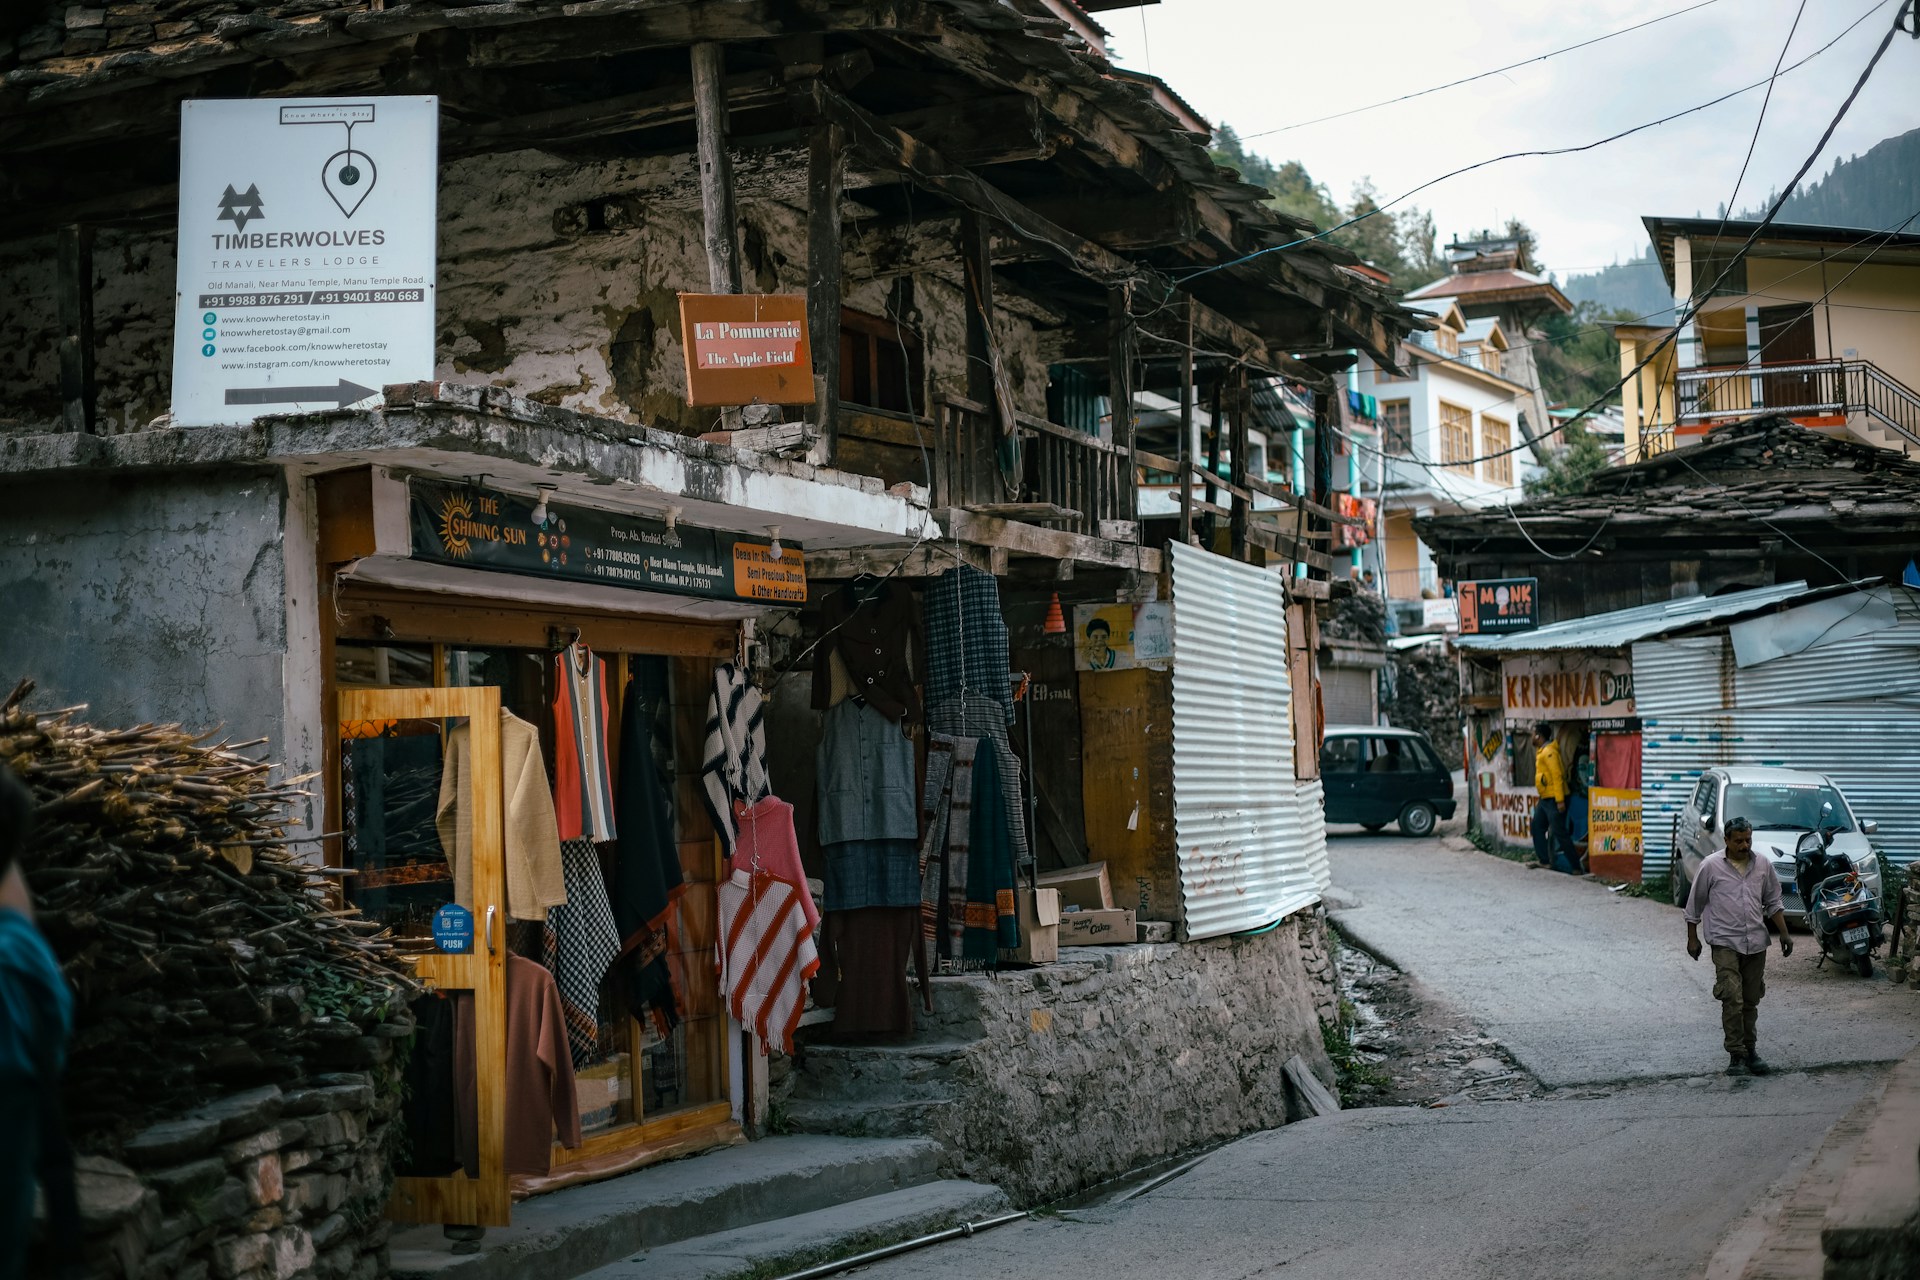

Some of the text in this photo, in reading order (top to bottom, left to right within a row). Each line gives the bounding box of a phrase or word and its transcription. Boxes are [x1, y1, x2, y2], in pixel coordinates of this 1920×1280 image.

[211, 229, 385, 250] TIMBERWOLVES
[211, 255, 379, 269] TRAVELERS LODGE
[208, 275, 426, 290] Old Manali, Near Manu Temple, Manu Temple Road.
[204, 296, 225, 306] +91
[228, 295, 257, 306] 9988
[259, 294, 281, 305] 876
[283, 293, 305, 304] 291
[319, 293, 340, 303] +91
[342, 292, 371, 302] 9401
[373, 291, 395, 302] 840
[397, 291, 419, 301] 668
[221, 313, 330, 324] www.knowwheretostay.in
[220, 326, 351, 337] knowwheretostay@gmail.com
[694, 321, 800, 340] La Pommeraie
[222, 341, 388, 354] www.facebook.com/knowwheretostay
[221, 357, 391, 370] www.instagram.com/knowwheretostay
[705, 350, 794, 367] The Apple Field
[479, 496, 499, 516] THE
[452, 518, 527, 545] SHINING SUN
[610, 526, 628, 542] Prop.
[629, 530, 641, 542] Ab.
[592, 547, 605, 560] +91
[735, 547, 752, 561] Deals
[593, 564, 606, 576] +91
[747, 566, 761, 580] Semi
[761, 567, 786, 582] Precious
[751, 584, 757, 597] &
[757, 585, 773, 598] Other
[1506, 670, 1598, 708] KRISHNA
[1592, 810, 1614, 822] BREAD
[443, 940, 463, 948] PUSH
